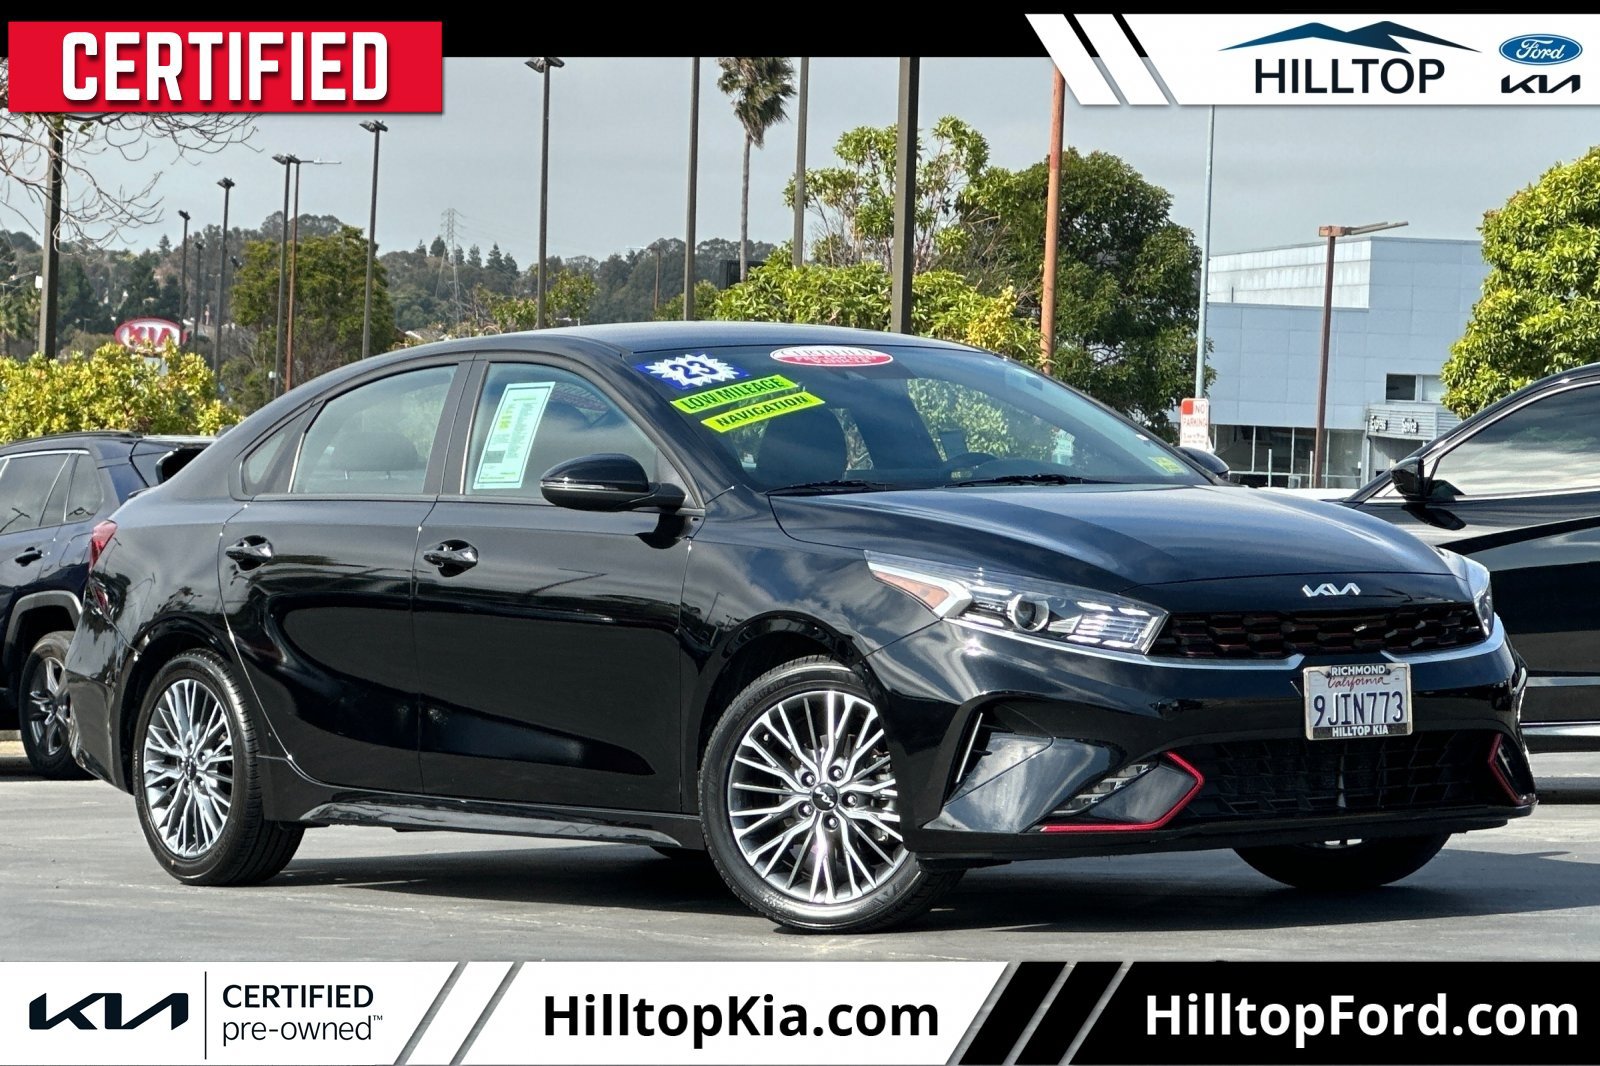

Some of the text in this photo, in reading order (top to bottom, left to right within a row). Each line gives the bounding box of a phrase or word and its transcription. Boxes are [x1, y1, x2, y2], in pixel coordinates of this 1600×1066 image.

[680, 377, 785, 411] LOW MILEAGE
[716, 396, 809, 427] NAVIGATION
[1194, 403, 1206, 414] NO
[1302, 582, 1361, 598] KIA
[1331, 665, 1386, 676] RICHMOND
[1327, 676, 1391, 692] California
[1313, 690, 1404, 727] 9JIN773
[1331, 725, 1389, 737] HILLTOP KIA
